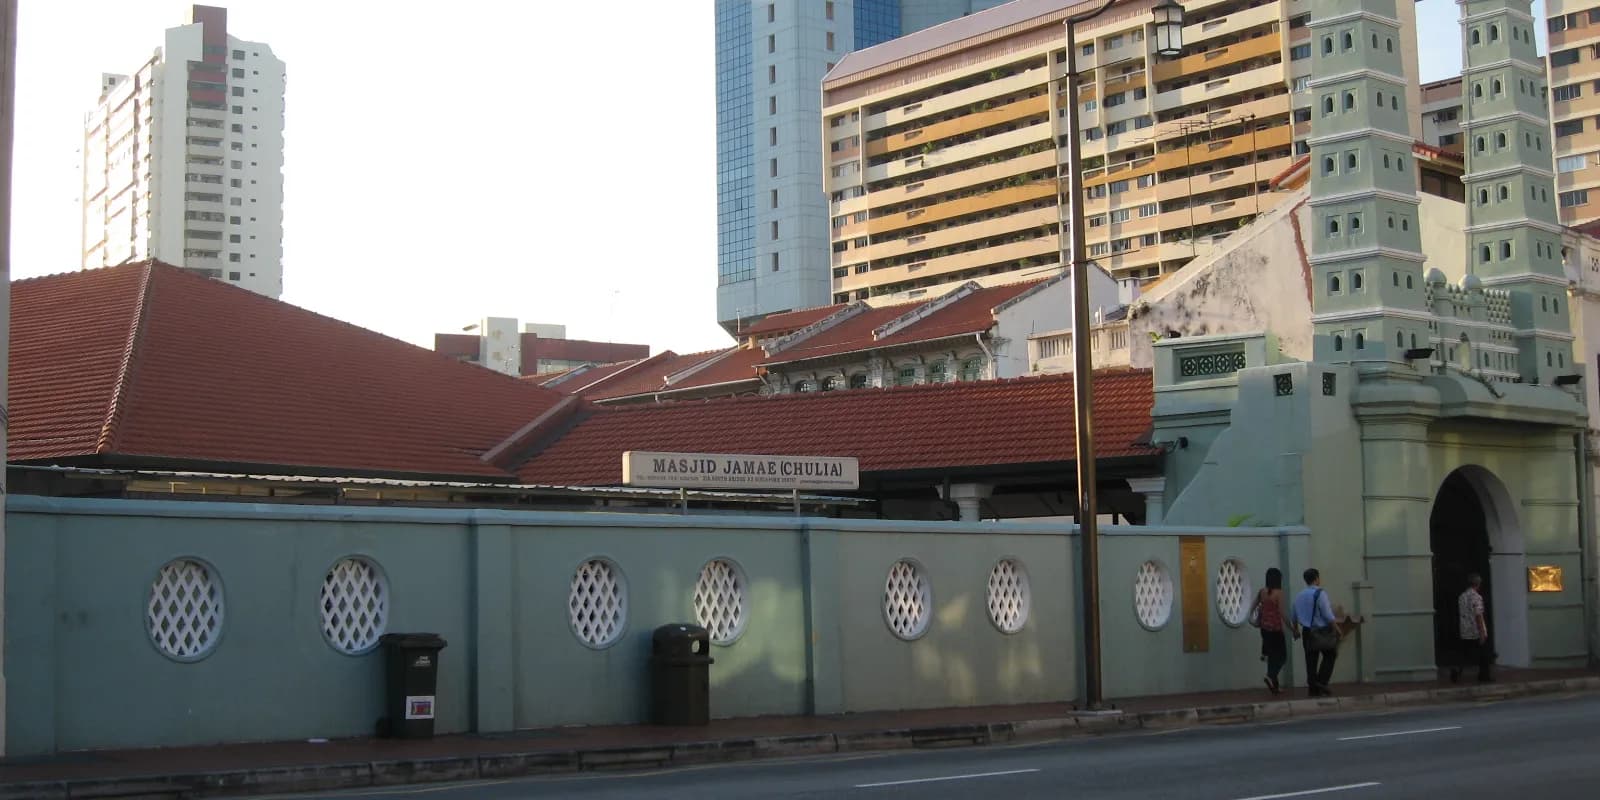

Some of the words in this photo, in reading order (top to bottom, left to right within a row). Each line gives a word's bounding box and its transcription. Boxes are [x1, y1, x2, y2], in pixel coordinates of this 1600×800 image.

[653, 458, 717, 474] MASJID
[723, 460, 777, 475] JAMAE
[780, 460, 843, 477] (CHULIA)
